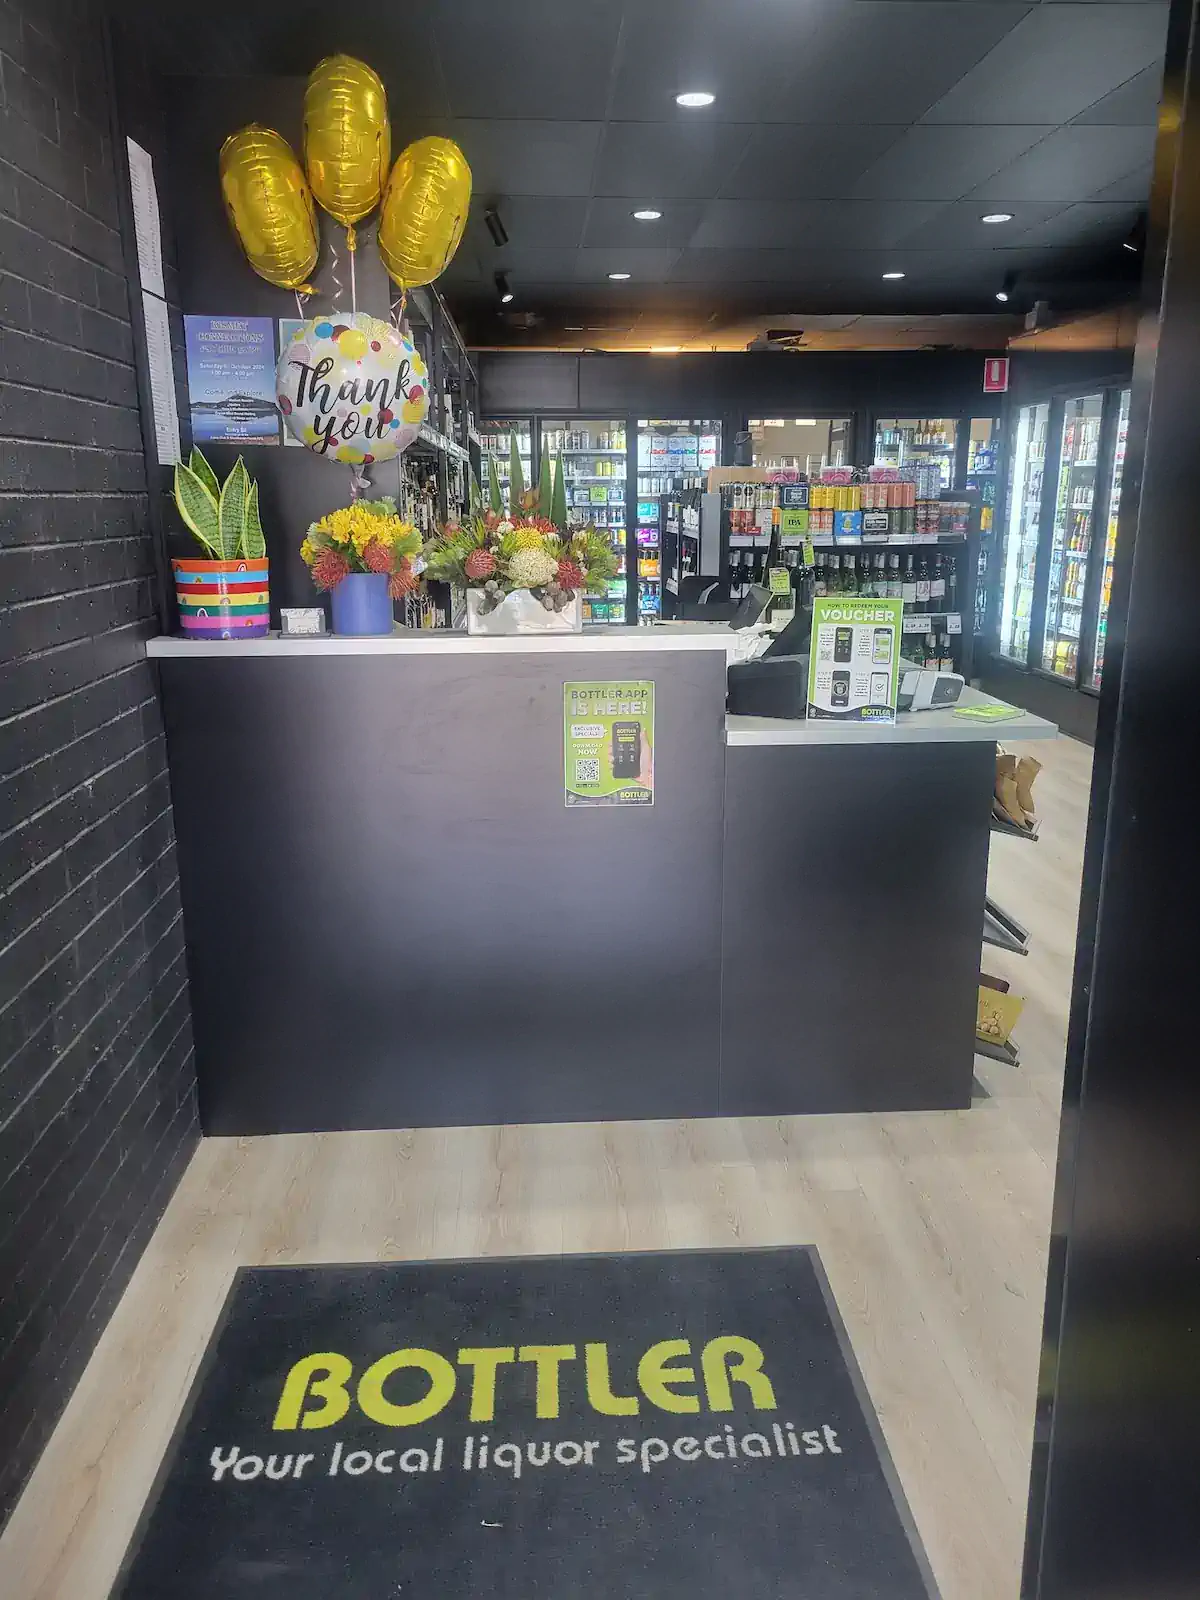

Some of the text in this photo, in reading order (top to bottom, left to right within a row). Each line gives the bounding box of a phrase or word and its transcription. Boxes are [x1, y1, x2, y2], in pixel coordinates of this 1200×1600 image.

[288, 357, 411, 414] Thank
[312, 411, 391, 454] you
[820, 609, 896, 622] VOUCHER
[571, 688, 648, 700] BOTTLER APP
[571, 700, 648, 716] IS HERE!
[861, 708, 891, 717] BOTTLER
[272, 1335, 777, 1431] BOTTLER
[210, 1422, 843, 1481] Your local liquor specialist
